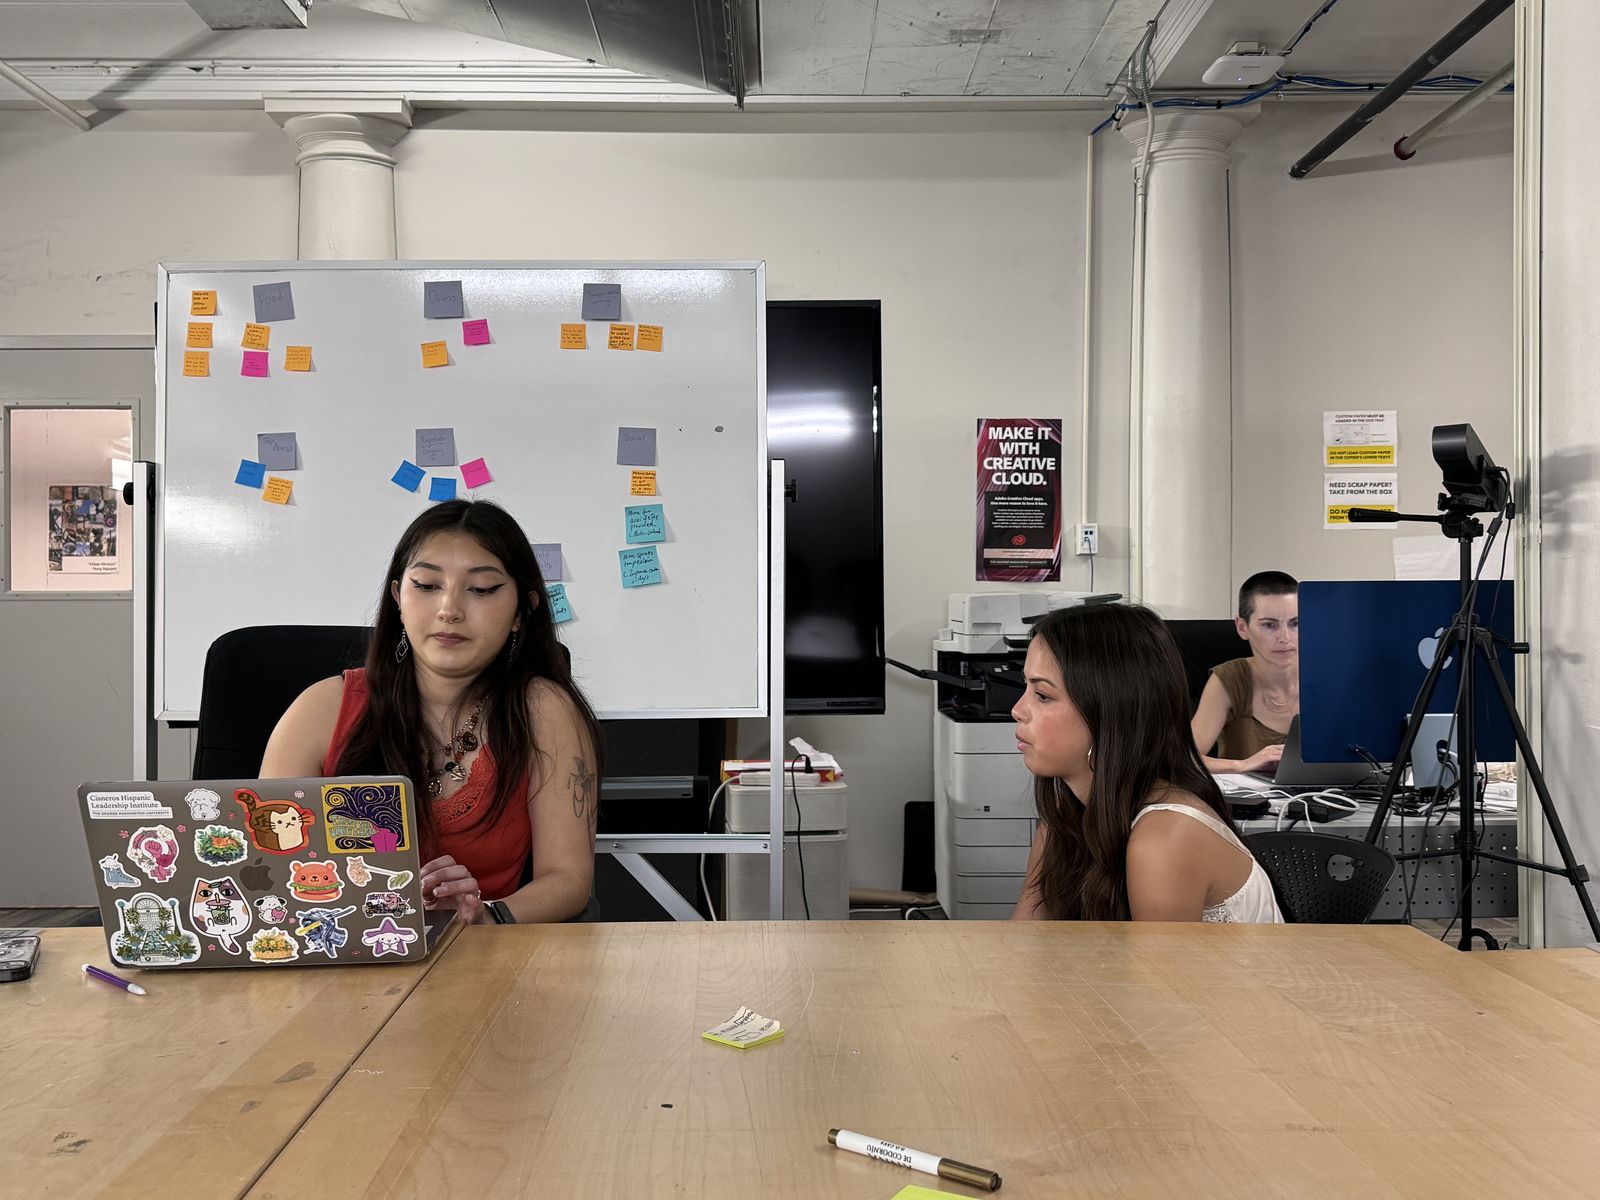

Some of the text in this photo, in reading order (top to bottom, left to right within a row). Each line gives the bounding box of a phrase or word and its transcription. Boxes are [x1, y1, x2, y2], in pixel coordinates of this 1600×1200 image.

[258, 288, 284, 307] Food
[429, 289, 458, 304] Dorms
[988, 427, 1052, 440] MAKE IT
[998, 442, 1040, 454] WITH
[983, 457, 1056, 470] CREATIVE
[992, 472, 1047, 485] CLOUD.
[866, 1144, 902, 1160] CODORNÍU
[903, 1155, 912, 1163] DE
